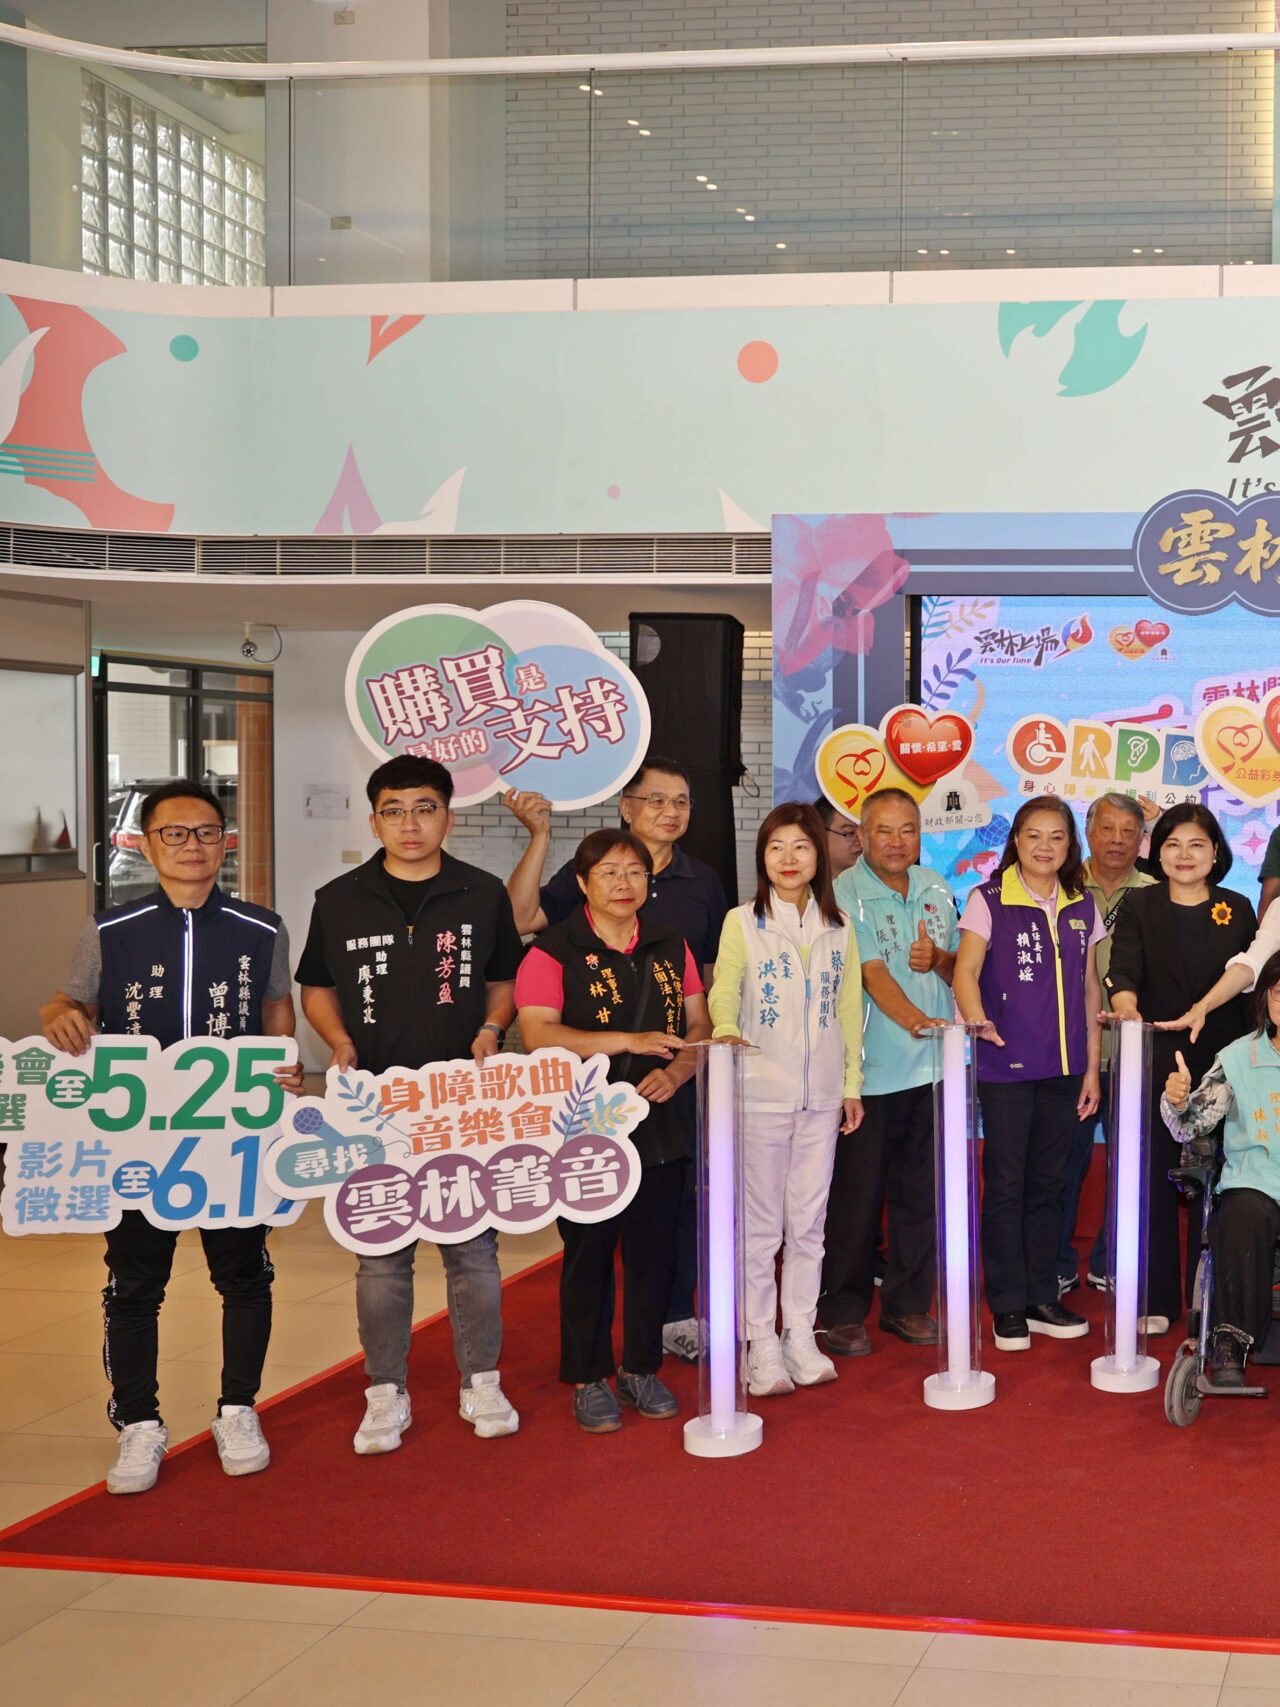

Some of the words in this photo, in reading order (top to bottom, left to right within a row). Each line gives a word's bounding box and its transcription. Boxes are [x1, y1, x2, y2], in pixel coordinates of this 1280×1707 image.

[1228, 477, 1276, 498] It's
[366, 644, 527, 745] 購買
[515, 663, 548, 694] 是
[485, 677, 629, 775] 支持
[924, 813, 984, 828] 財政部關心您
[346, 934, 395, 951] 服務團隊
[375, 951, 388, 975] 助理
[435, 931, 458, 1005] 陳芳盈
[459, 924, 473, 988] 雲林縣議員
[779, 952, 794, 979] 愛妻
[1031, 922, 1043, 964] 主任委員
[149, 964, 165, 999] 助理
[238, 955, 252, 1032] 雲林縣議員
[757, 959, 781, 1028] 洪惠玲
[818, 971, 830, 1030] 服務團隊
[0, 1047, 56, 1086] 會
[52, 1075, 86, 1103] 至
[88, 1046, 286, 1132] 5.25
[379, 1057, 573, 1116] 身障歌曲
[409, 1101, 554, 1156] 音樂會
[15, 1186, 111, 1224] 徵選
[118, 1166, 154, 1194] 至
[152, 1136, 294, 1221] 6.1
[17, 1140, 111, 1179] 影片
[294, 1143, 369, 1180] 尋找
[345, 1146, 621, 1235] 雲林菁音
